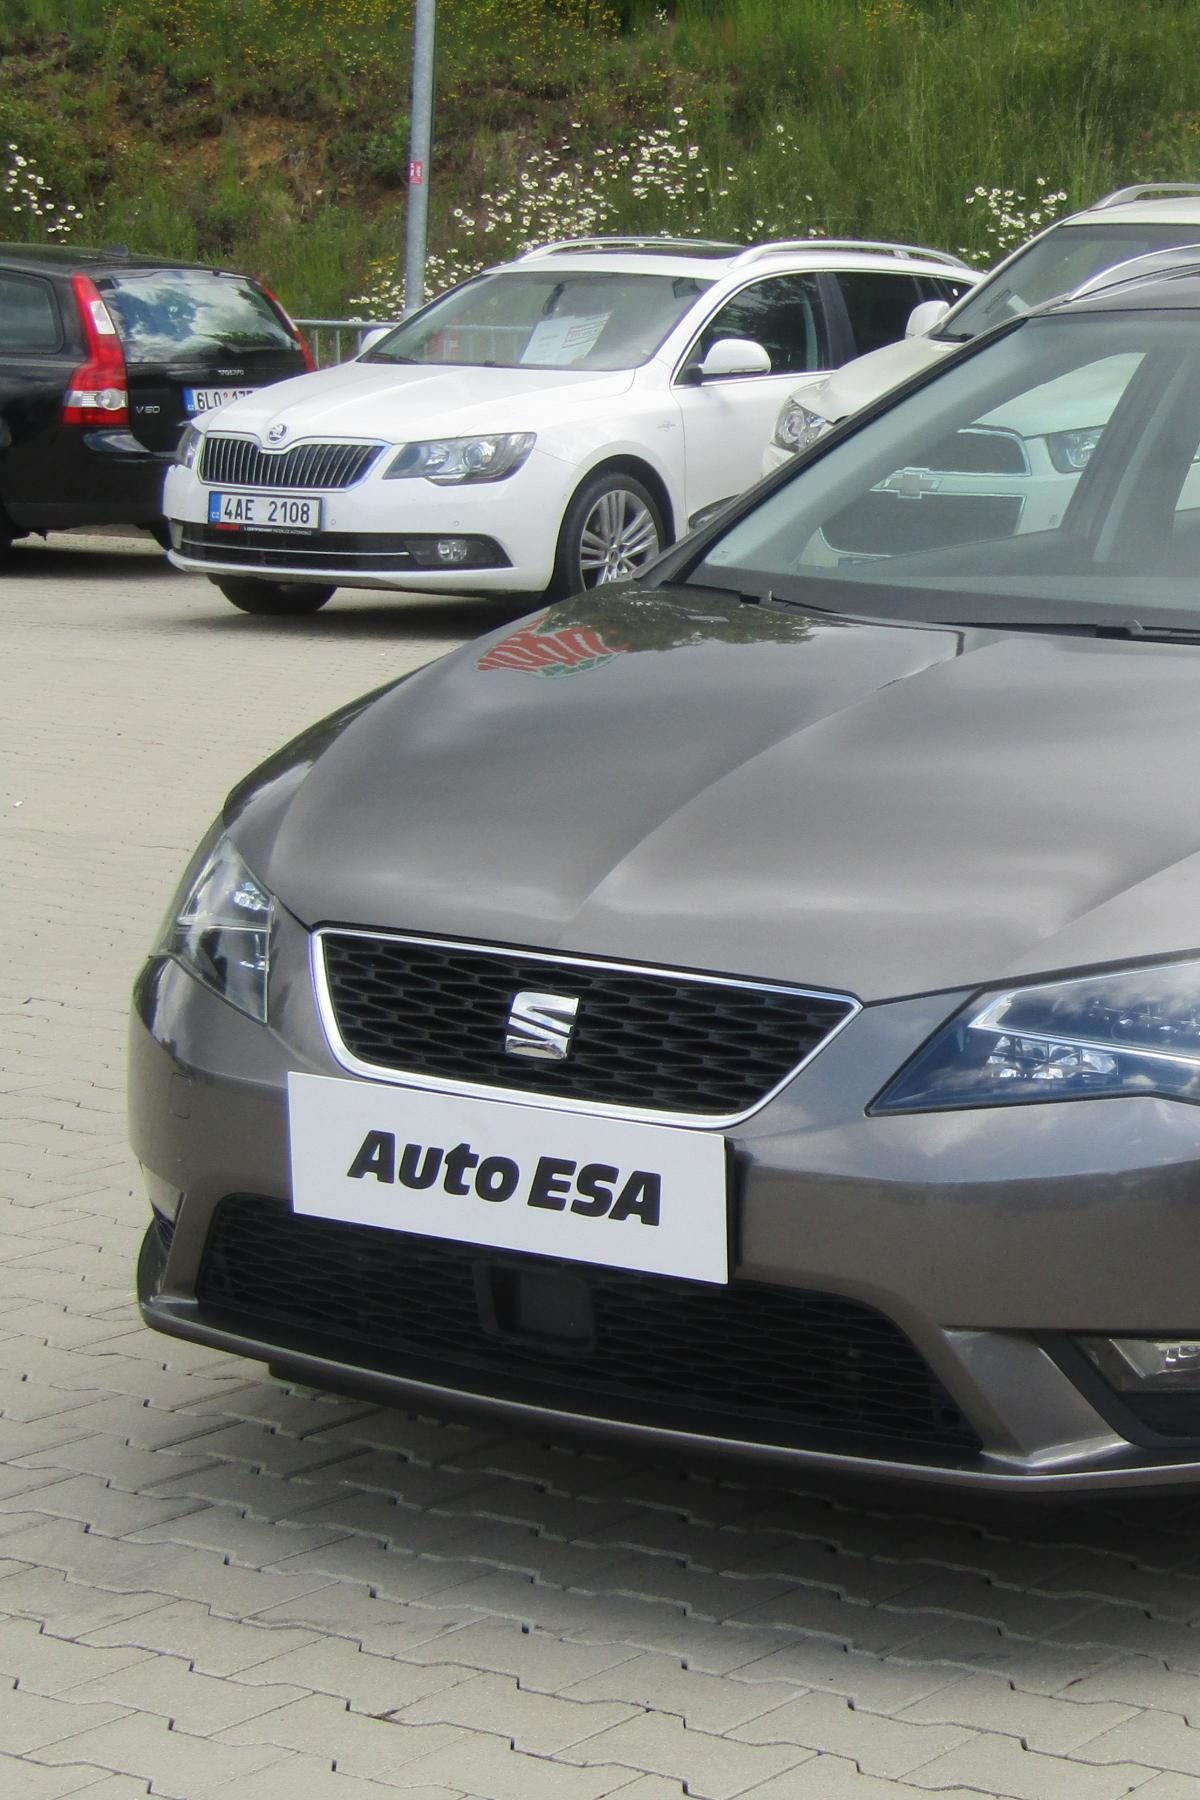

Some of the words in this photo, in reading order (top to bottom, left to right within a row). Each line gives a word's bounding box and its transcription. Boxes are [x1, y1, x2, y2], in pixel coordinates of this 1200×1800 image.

[224, 498, 255, 521] 4AE
[268, 500, 310, 524] 2108
[347, 1130, 520, 1203] Auto
[527, 1156, 662, 1227] ESA
